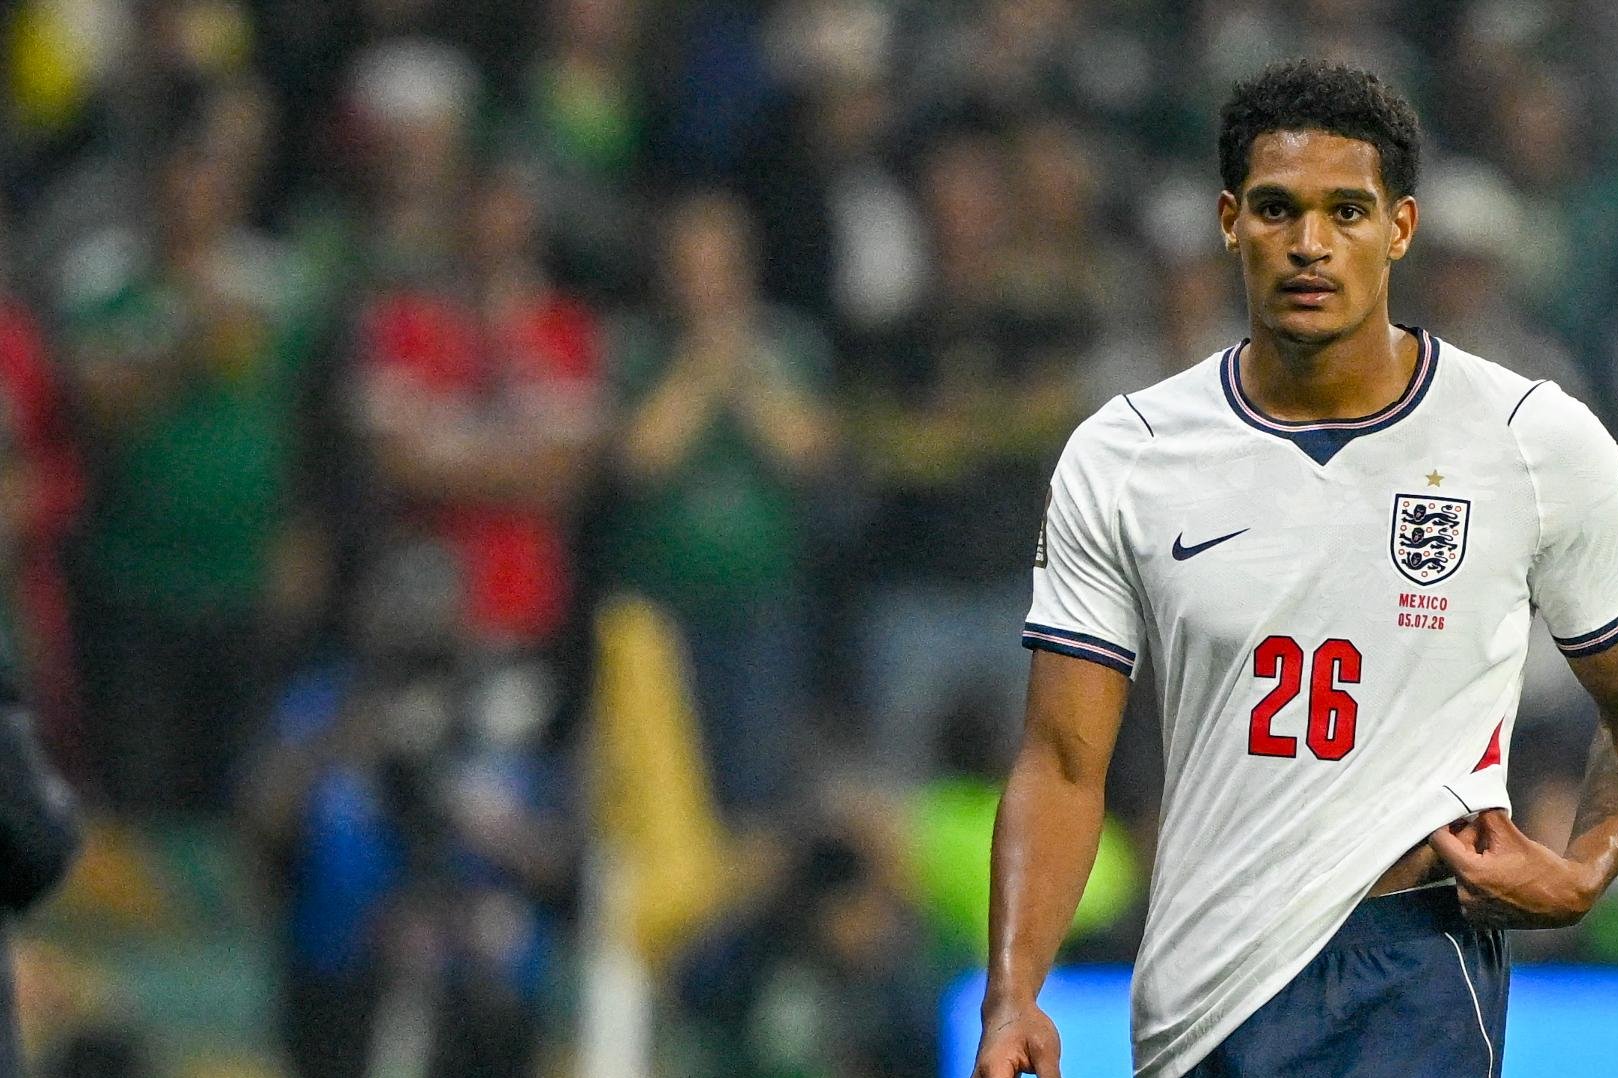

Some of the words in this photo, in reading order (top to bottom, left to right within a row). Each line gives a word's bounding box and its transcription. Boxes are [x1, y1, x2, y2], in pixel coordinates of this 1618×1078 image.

[1398, 593, 1448, 611] MEXICO
[1398, 613, 1445, 630] 05.07.26
[1248, 635, 1362, 761] 26
